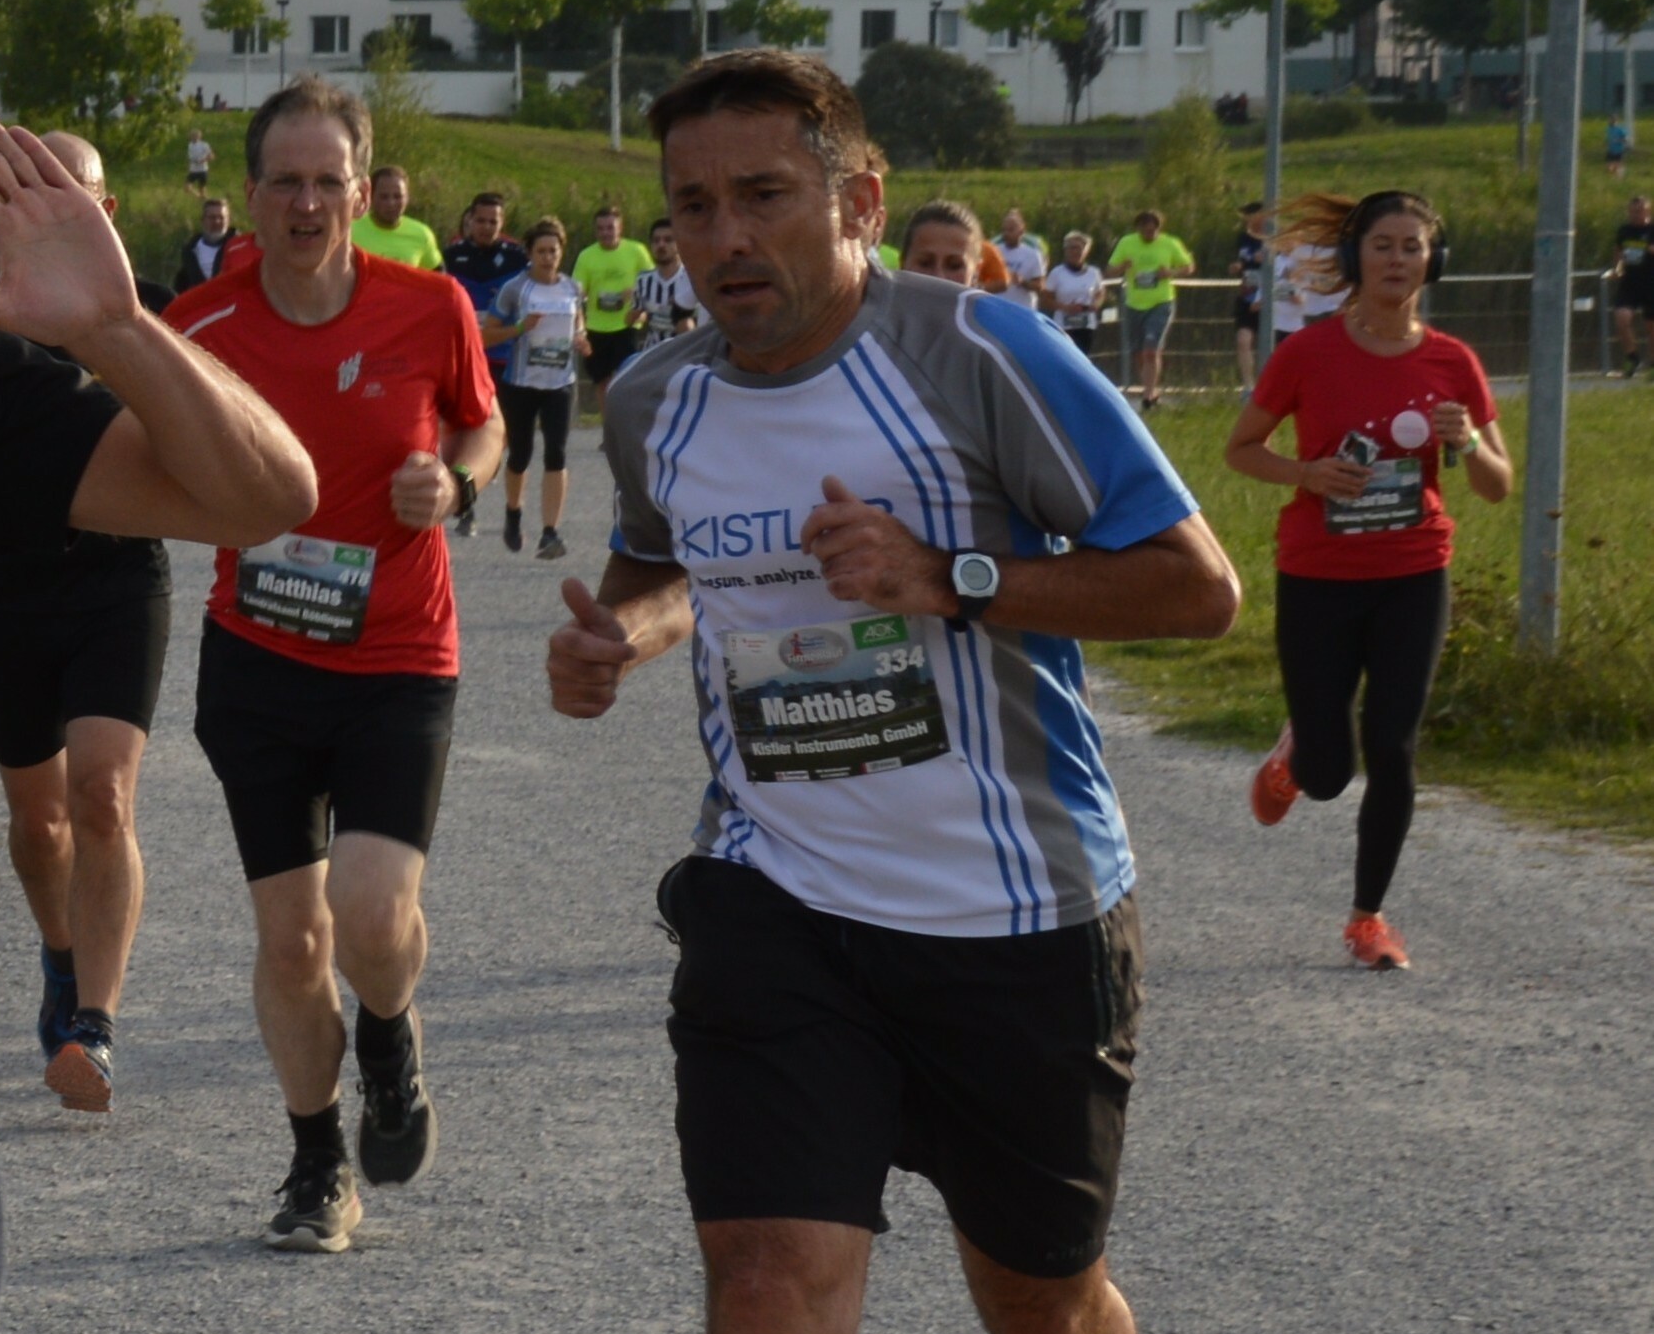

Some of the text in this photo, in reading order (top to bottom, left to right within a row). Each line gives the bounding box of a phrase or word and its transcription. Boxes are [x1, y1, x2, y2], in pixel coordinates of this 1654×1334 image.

[681, 498, 893, 559] KISTL
[257, 570, 343, 607] Matthias
[755, 568, 822, 586] analyze.
[863, 621, 897, 641] AOK
[875, 645, 925, 676] 334
[760, 690, 896, 726] Matthias
[751, 721, 929, 756] Kistler Instrumente GmbH
